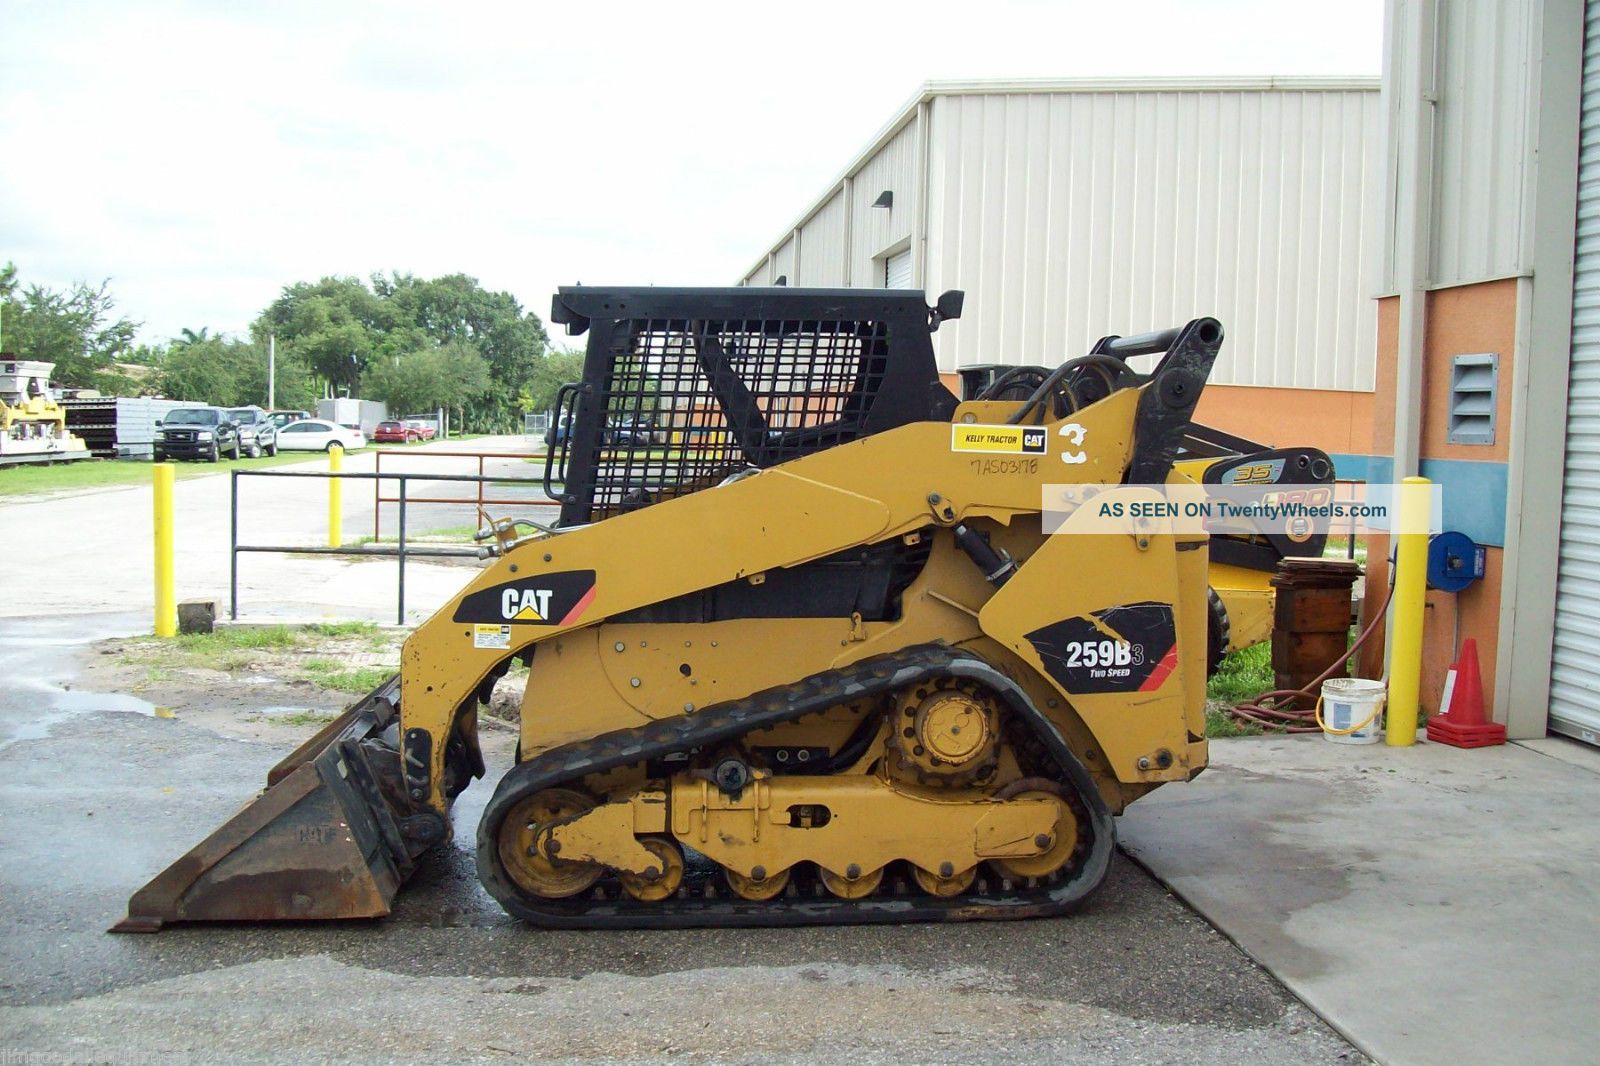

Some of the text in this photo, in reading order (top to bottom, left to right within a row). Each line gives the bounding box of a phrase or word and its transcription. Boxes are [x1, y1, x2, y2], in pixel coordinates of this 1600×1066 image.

[965, 434, 1018, 444] KELLY TRACTOR
[1024, 434, 1045, 448] CAT
[501, 588, 553, 621] CAT
